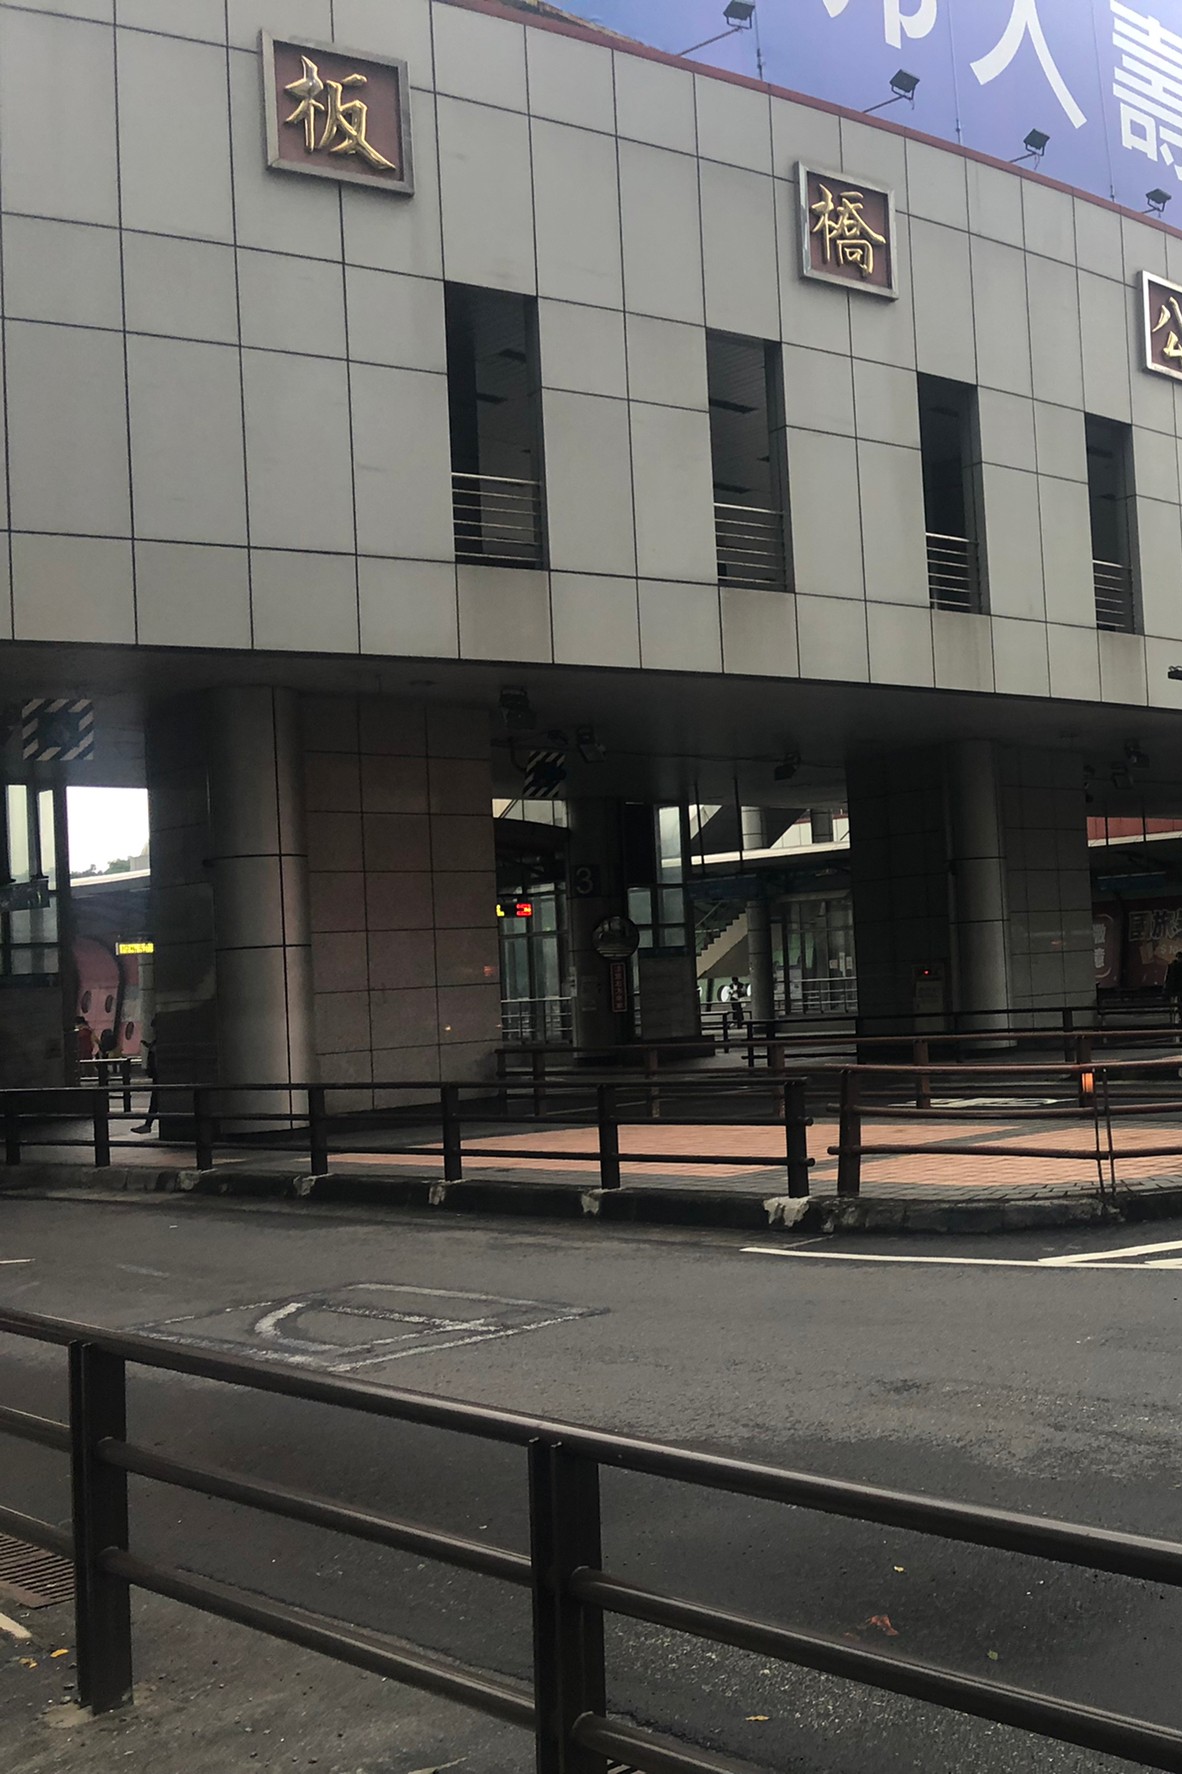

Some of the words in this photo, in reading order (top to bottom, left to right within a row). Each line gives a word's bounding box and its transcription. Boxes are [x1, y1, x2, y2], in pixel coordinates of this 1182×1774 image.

[285, 56, 396, 171] 板
[810, 183, 886, 278] 橋
[575, 866, 594, 895] 3
